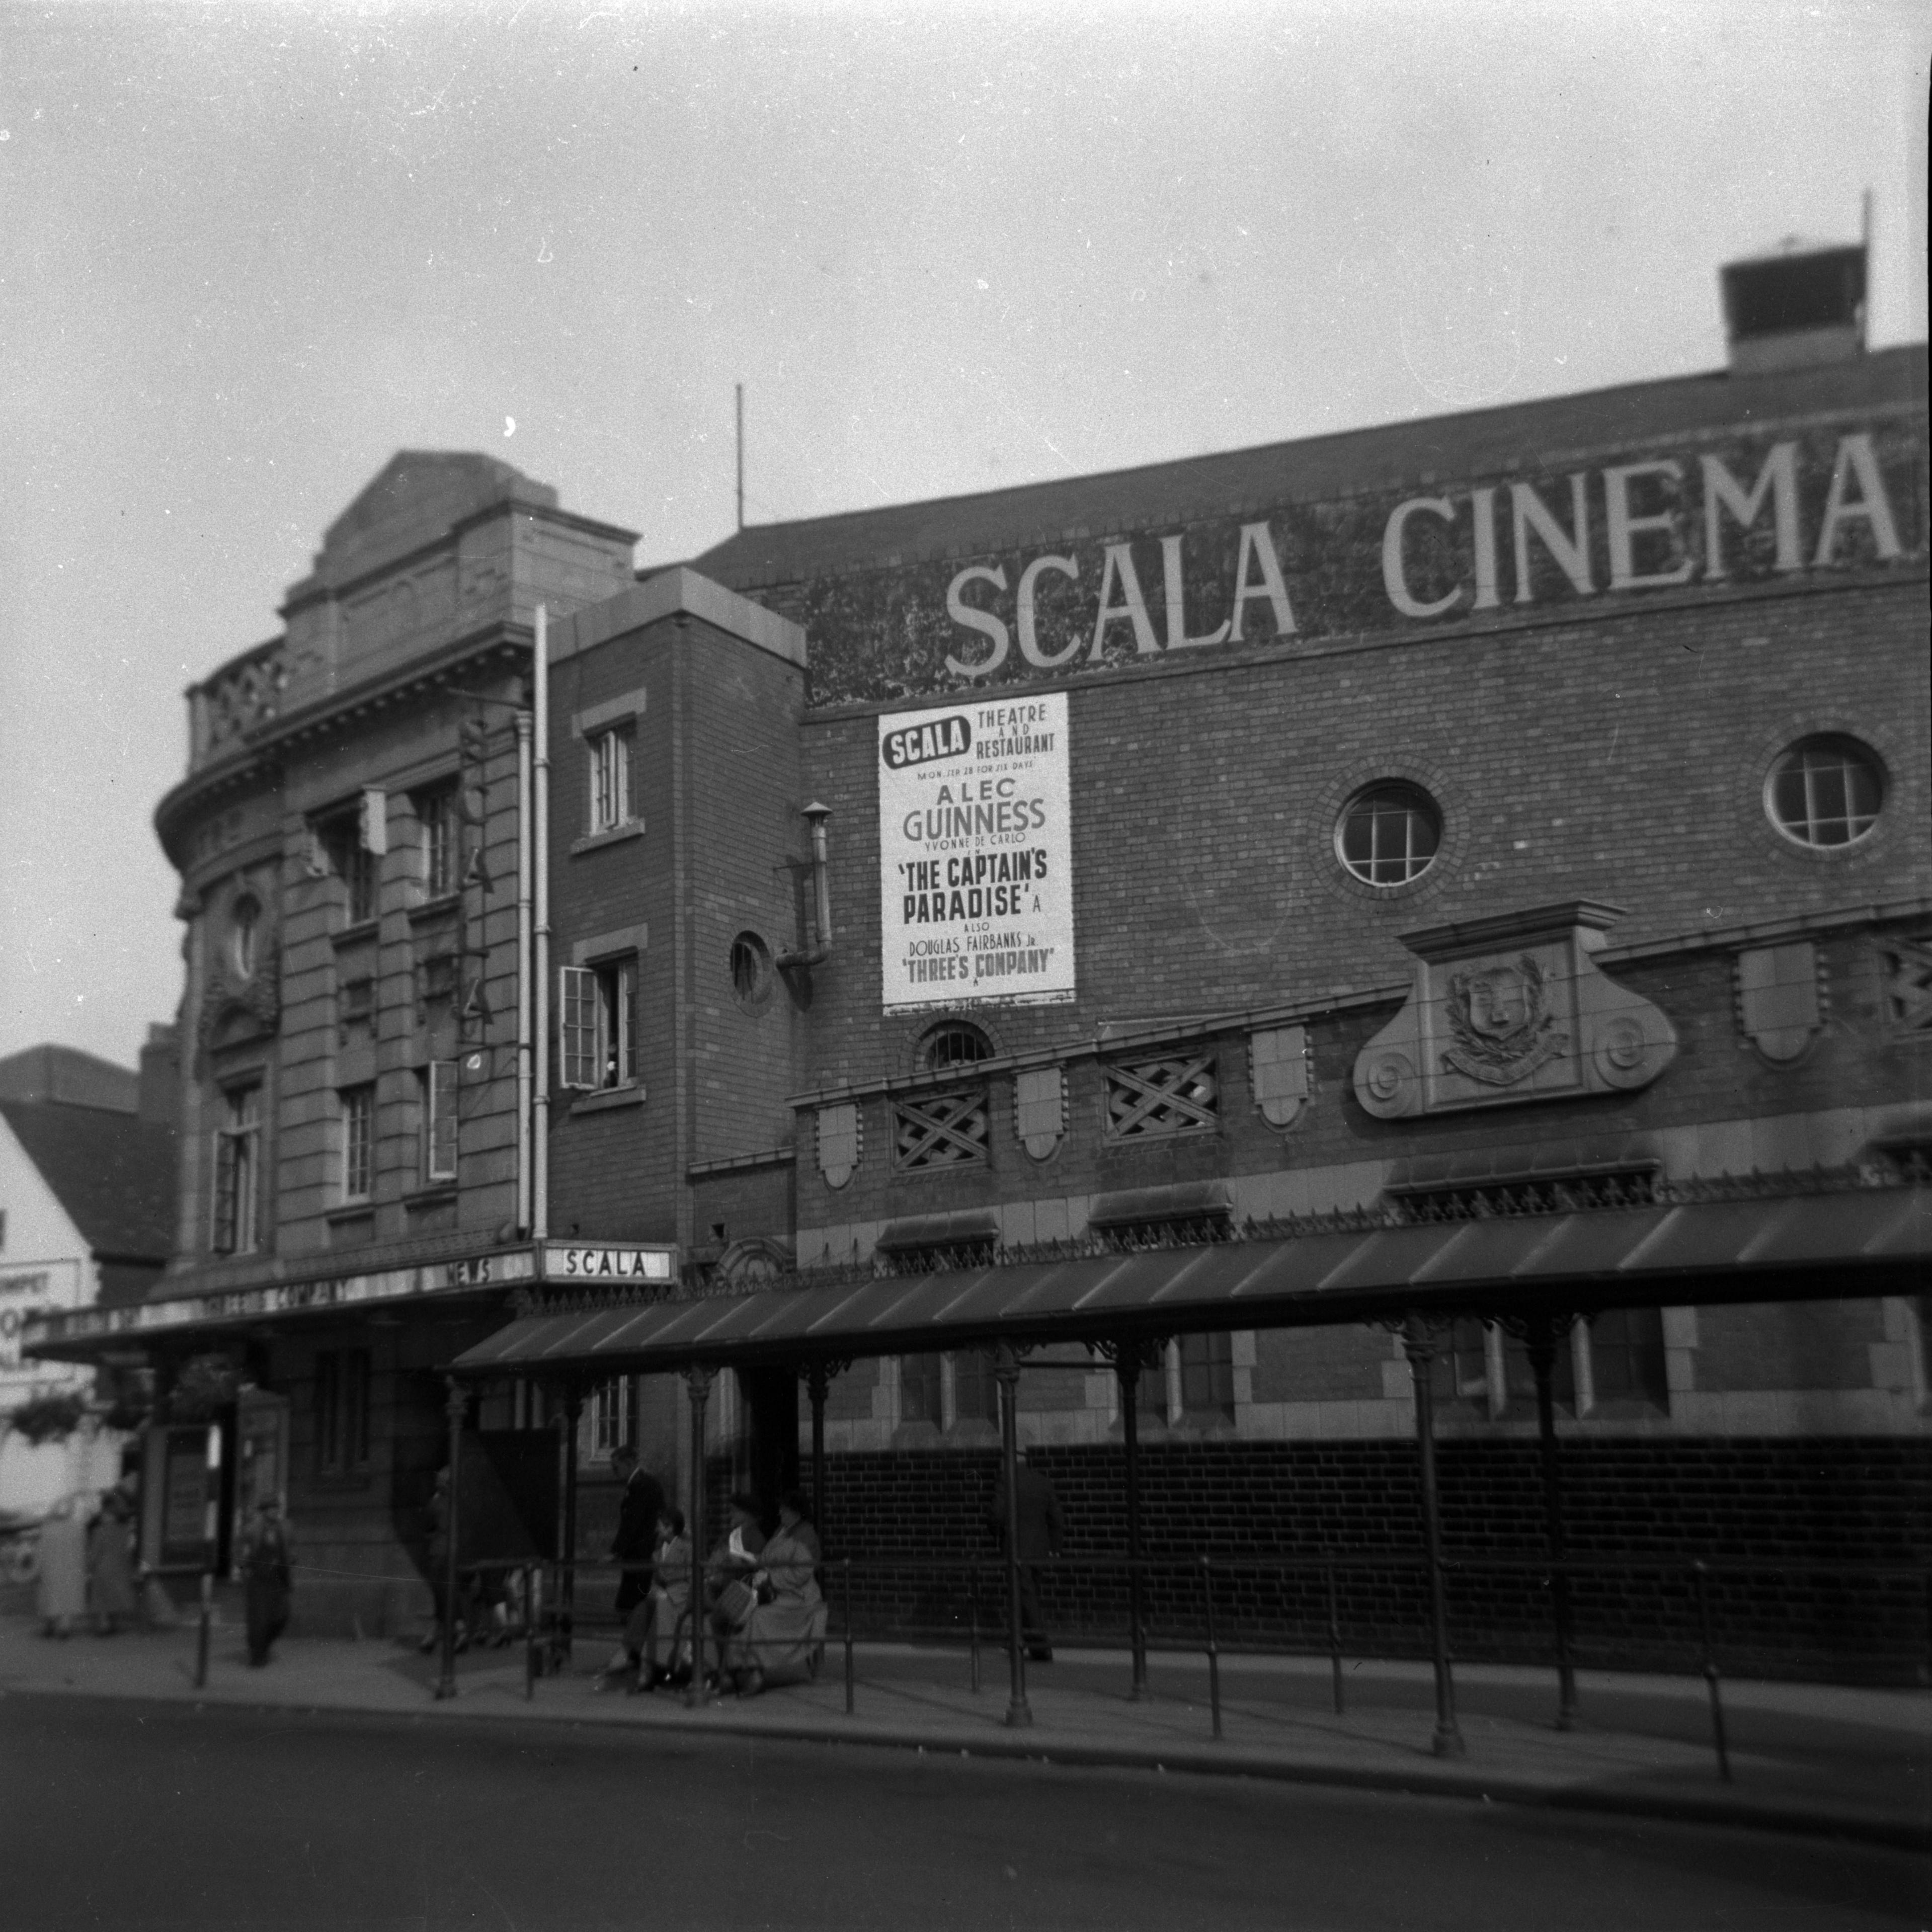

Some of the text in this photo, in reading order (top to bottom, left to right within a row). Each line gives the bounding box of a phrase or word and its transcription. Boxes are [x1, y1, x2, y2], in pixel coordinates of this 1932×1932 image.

[944, 433, 1903, 678] SCALA CINEMA
[978, 703, 1046, 729] THEATRE
[890, 718, 964, 764] SCALA
[999, 723, 1029, 738] AND
[977, 733, 1055, 760] RESTAURANT
[964, 766, 973, 775] 28
[977, 765, 993, 774] FOR
[996, 763, 1008, 772] SIX
[1012, 760, 1032, 770] DAYS
[936, 778, 1016, 805] ALEC
[903, 798, 1046, 841] GUINNESS
[925, 832, 1026, 851] YVONNE DE CARLO
[947, 847, 1047, 887] CAPTAIN'S
[1033, 895, 1041, 913] A
[964, 922, 990, 933] ALSO
[910, 937, 960, 956] DOUGLAS
[967, 931, 1021, 951] FAIRBANKS
[447, 1258, 491, 1286] NEWS
[566, 1249, 646, 1275] SCALA
